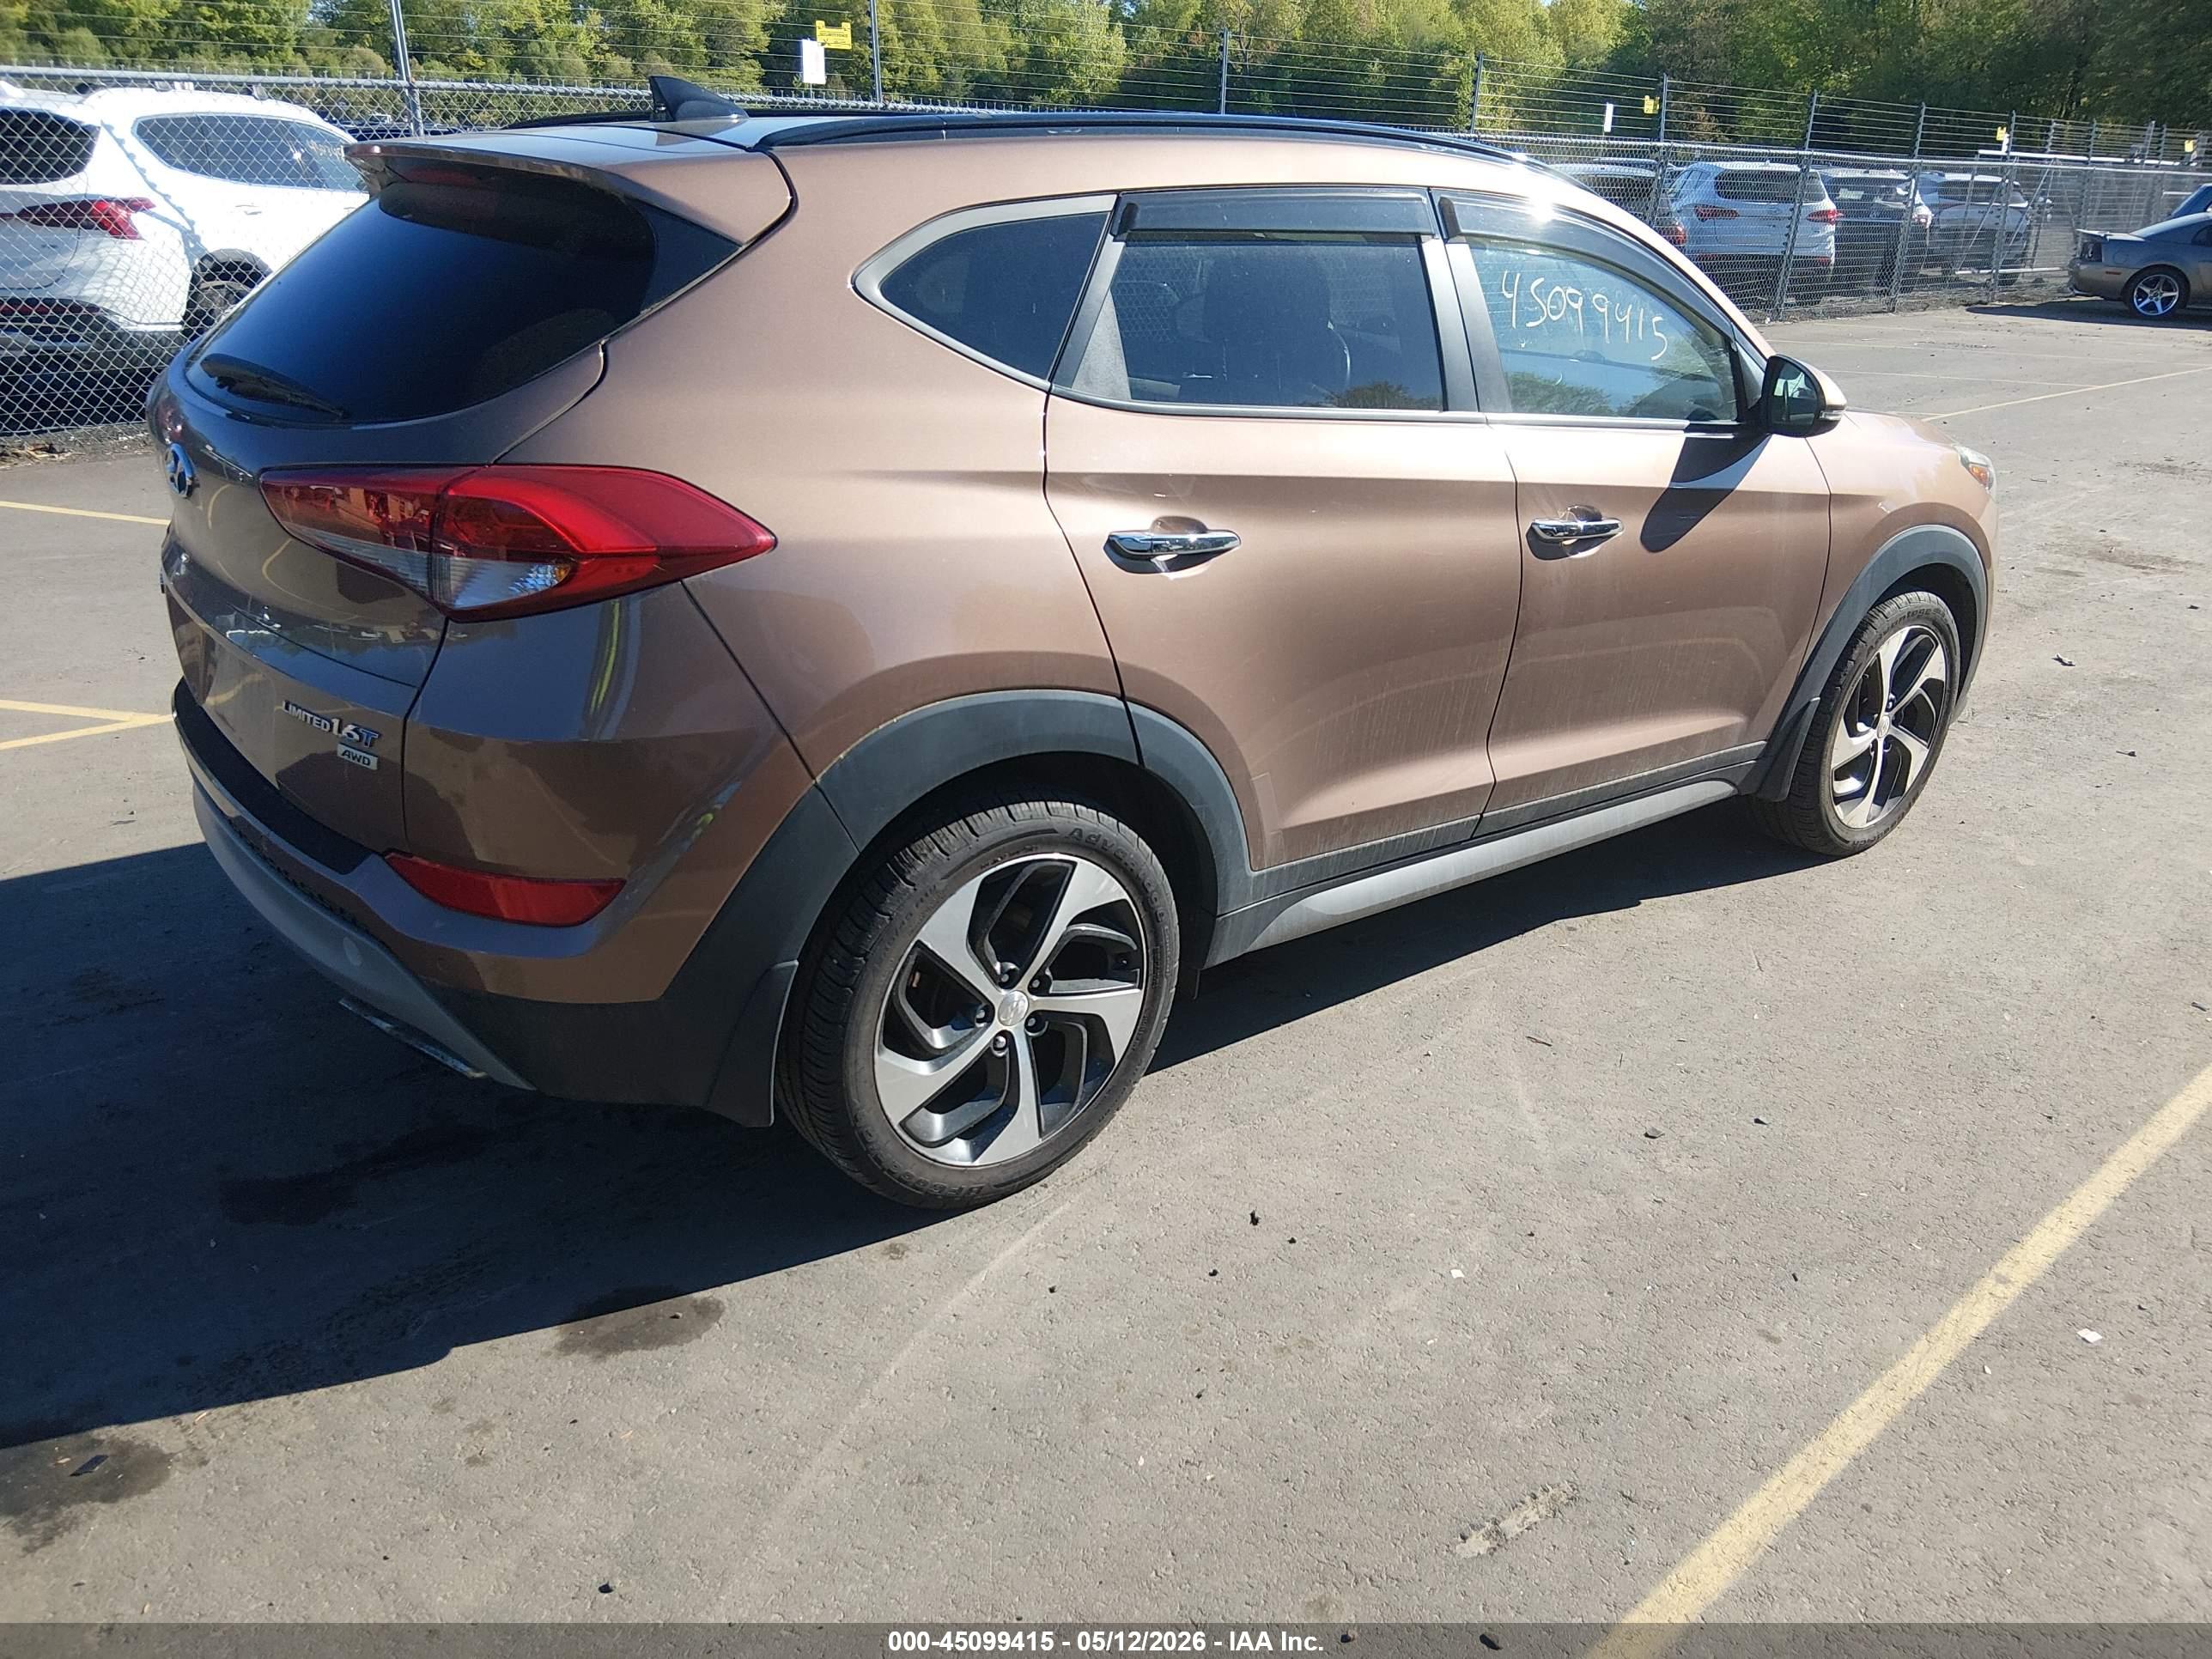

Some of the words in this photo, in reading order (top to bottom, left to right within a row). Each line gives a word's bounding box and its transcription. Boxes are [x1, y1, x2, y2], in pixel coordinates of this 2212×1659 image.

[1502, 270, 1668, 361] 45099415
[282, 700, 331, 732] LIMITED
[341, 749, 371, 766] AWD
